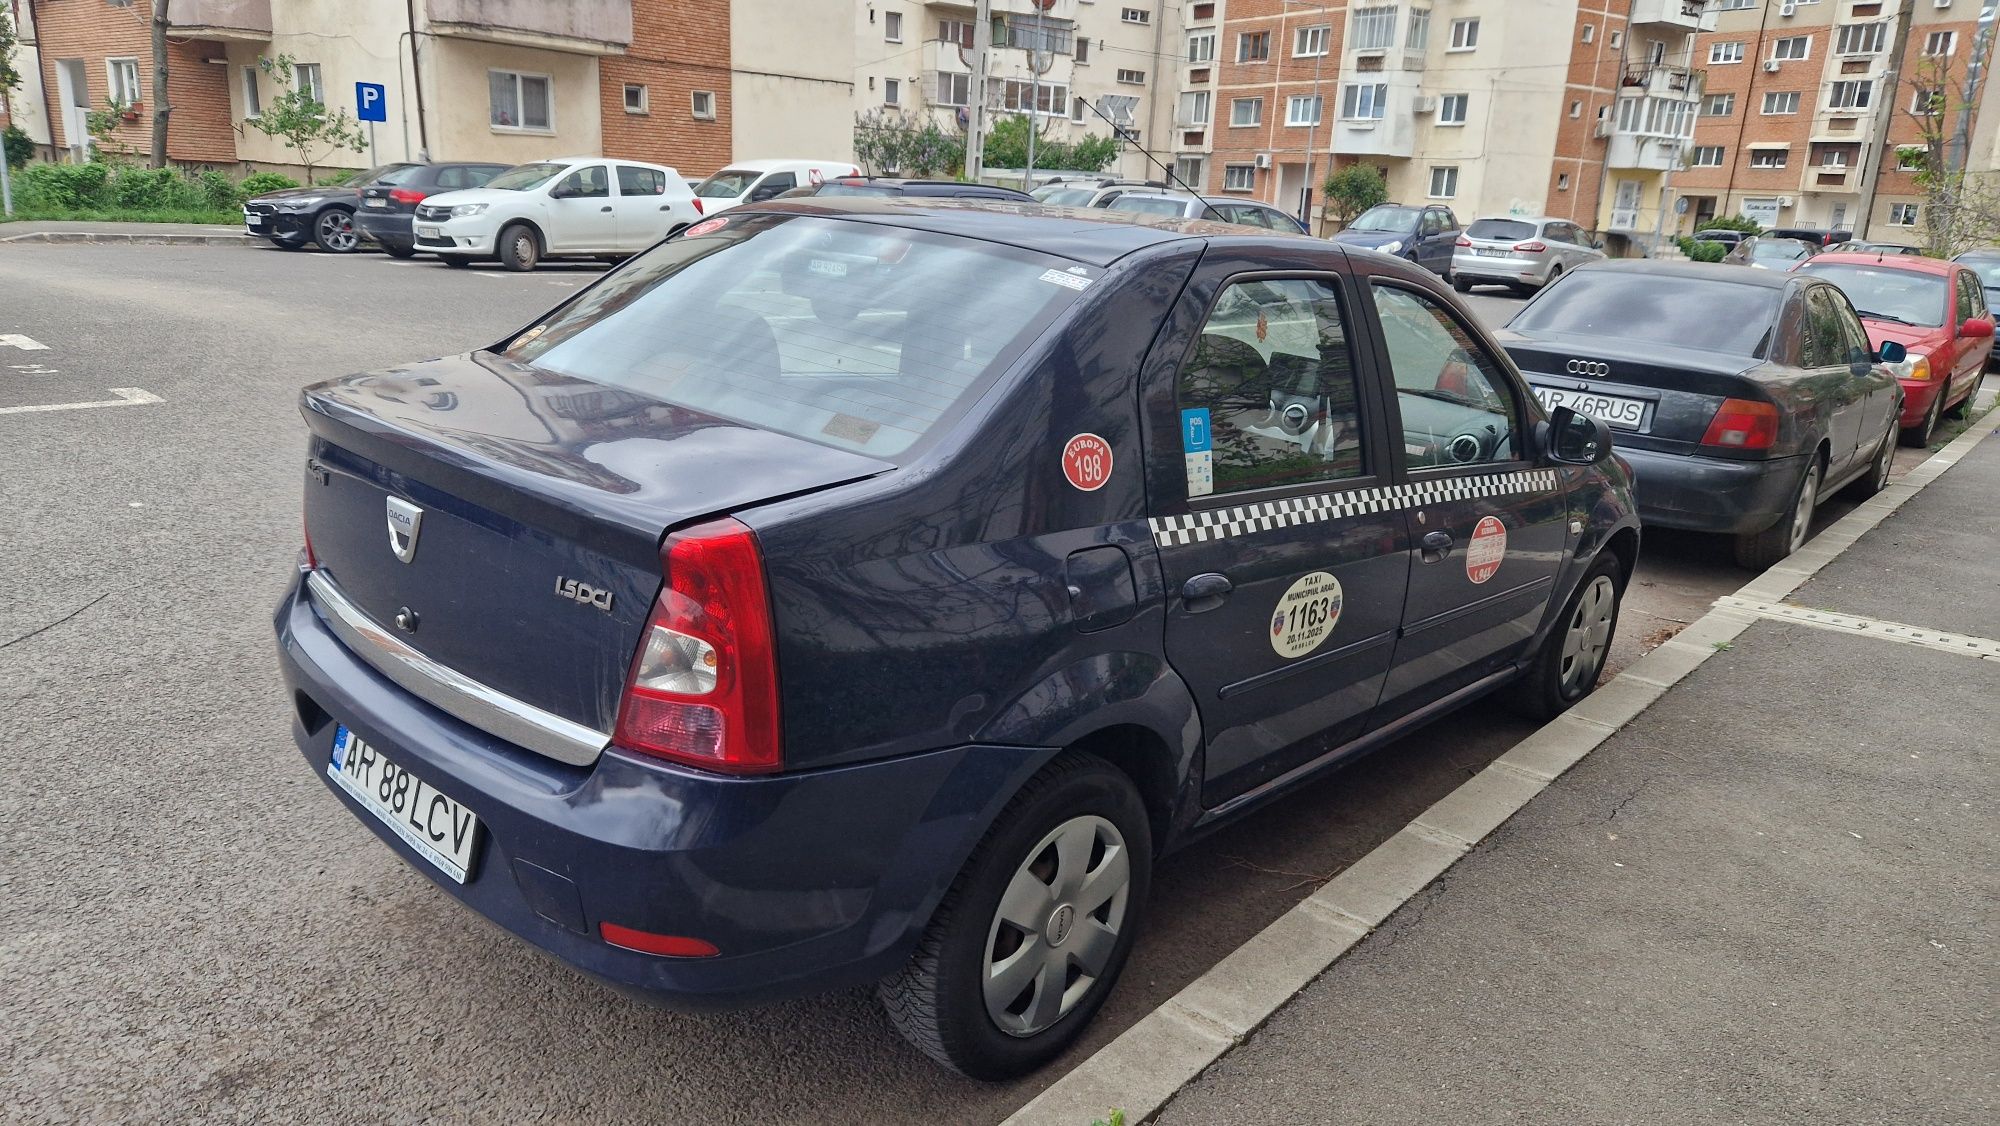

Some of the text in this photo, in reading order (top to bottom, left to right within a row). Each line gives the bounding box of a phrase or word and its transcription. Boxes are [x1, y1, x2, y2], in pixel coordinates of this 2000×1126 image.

[363, 87, 378, 109] P
[1536, 391, 1564, 411] AR
[1068, 439, 1104, 459] EUROPA
[1075, 454, 1102, 483] 198
[389, 509, 411, 526] DACIA
[1304, 574, 1322, 587] TAXI
[1287, 582, 1335, 601] MUNICIPIUL ARAD
[1289, 597, 1329, 633] 1163
[1286, 626, 1323, 645] 20.11.2025
[344, 736, 376, 788] AR
[379, 759, 410, 814] 88
[409, 779, 471, 856] LCV
